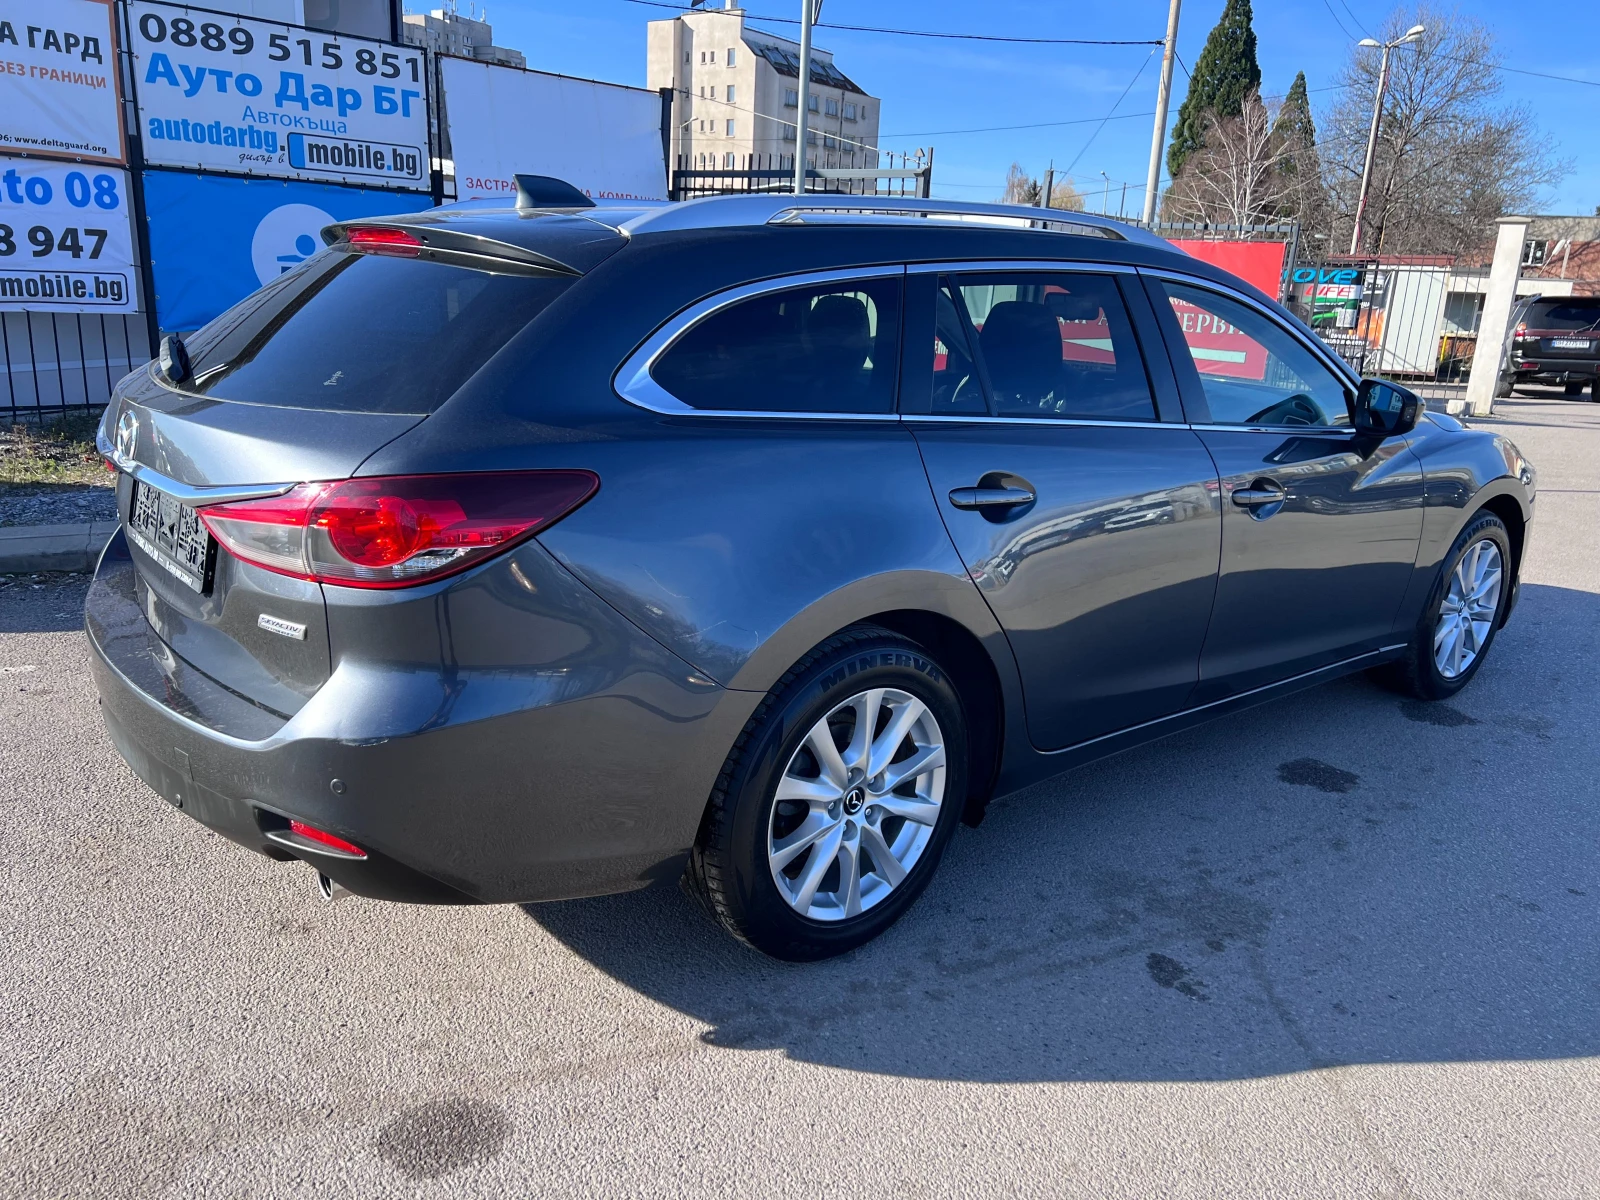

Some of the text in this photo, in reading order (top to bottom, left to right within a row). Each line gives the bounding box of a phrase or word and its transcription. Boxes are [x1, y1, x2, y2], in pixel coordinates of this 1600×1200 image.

[26, 25, 103, 65] ГАРД
[139, 13, 419, 83] 0889 515 851
[29, 65, 107, 90] ГРАНИЦИ
[145, 52, 420, 118] Ауто Дар БГ
[242, 105, 347, 135] Автокъща
[14, 136, 107, 154] www.deltaguard.org
[307, 142, 417, 176] mobile.bg
[0, 168, 120, 210] to 08
[27, 225, 108, 260] 947
[0, 274, 123, 302] mobile.bg
[1283, 268, 1358, 284] ove
[1457, 519, 1503, 553] MINERVA
[820, 653, 941, 693] MINERVA
